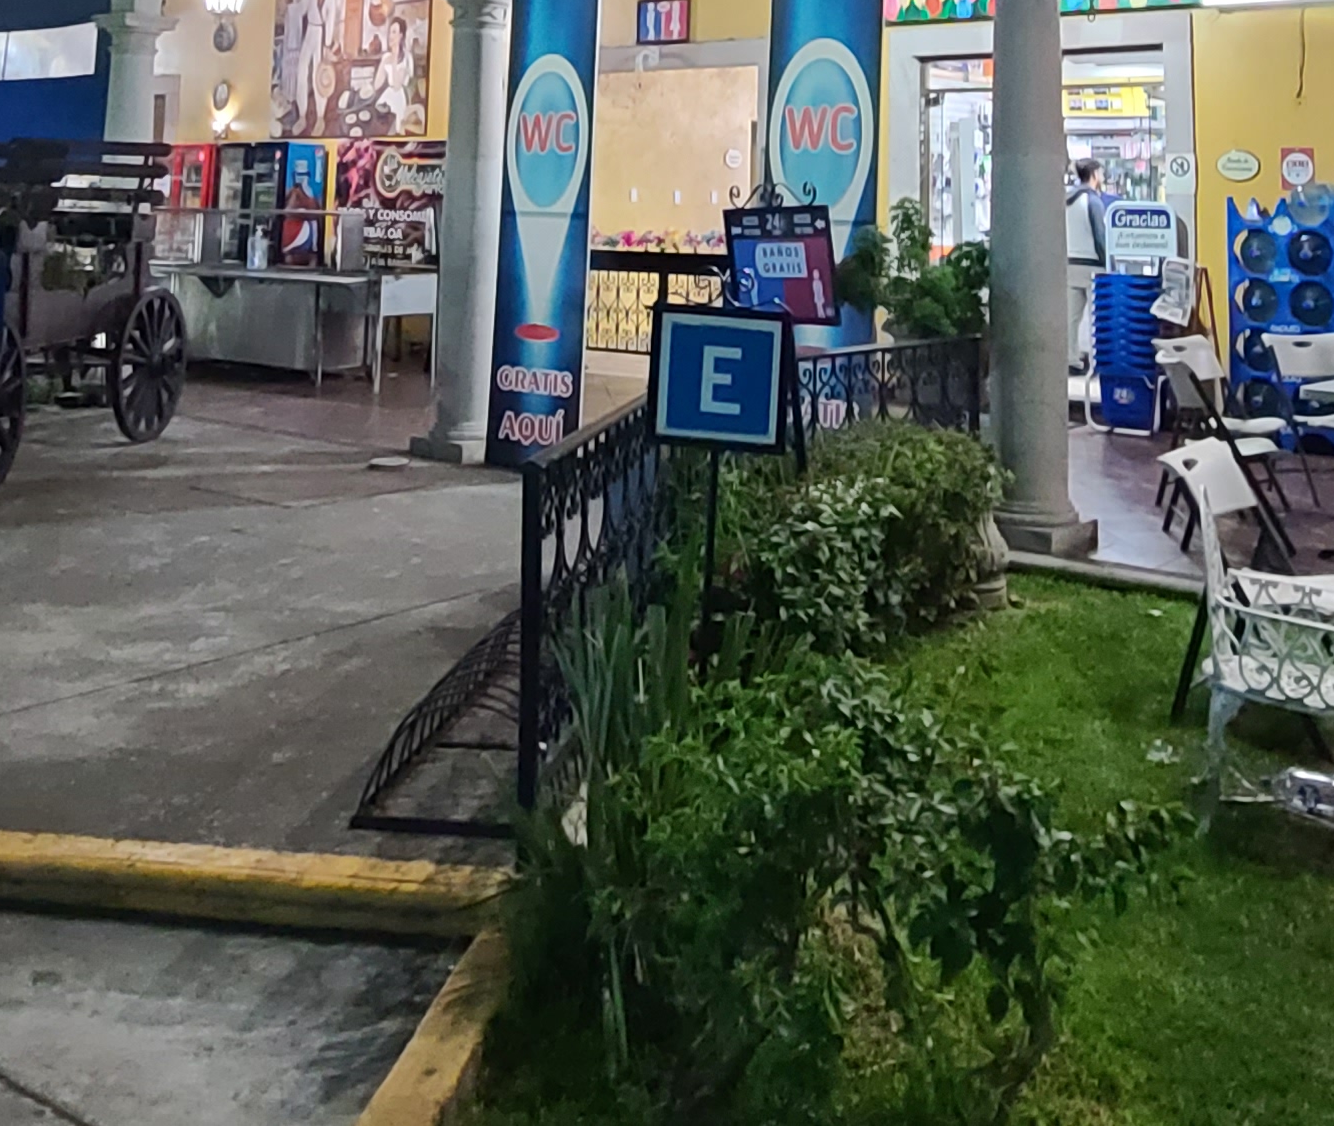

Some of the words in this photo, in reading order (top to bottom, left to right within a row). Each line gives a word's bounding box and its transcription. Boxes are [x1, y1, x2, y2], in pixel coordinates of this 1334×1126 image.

[520, 111, 577, 154] WC
[785, 103, 857, 153] WC
[765, 212, 780, 231] 24
[1114, 209, 1168, 227] Gracias
[762, 245, 800, 259] BAÑOS
[763, 262, 803, 274] GRATIS
[497, 364, 573, 398] GRATIS
[699, 344, 743, 416] E
[499, 406, 565, 446] AQUÍ
